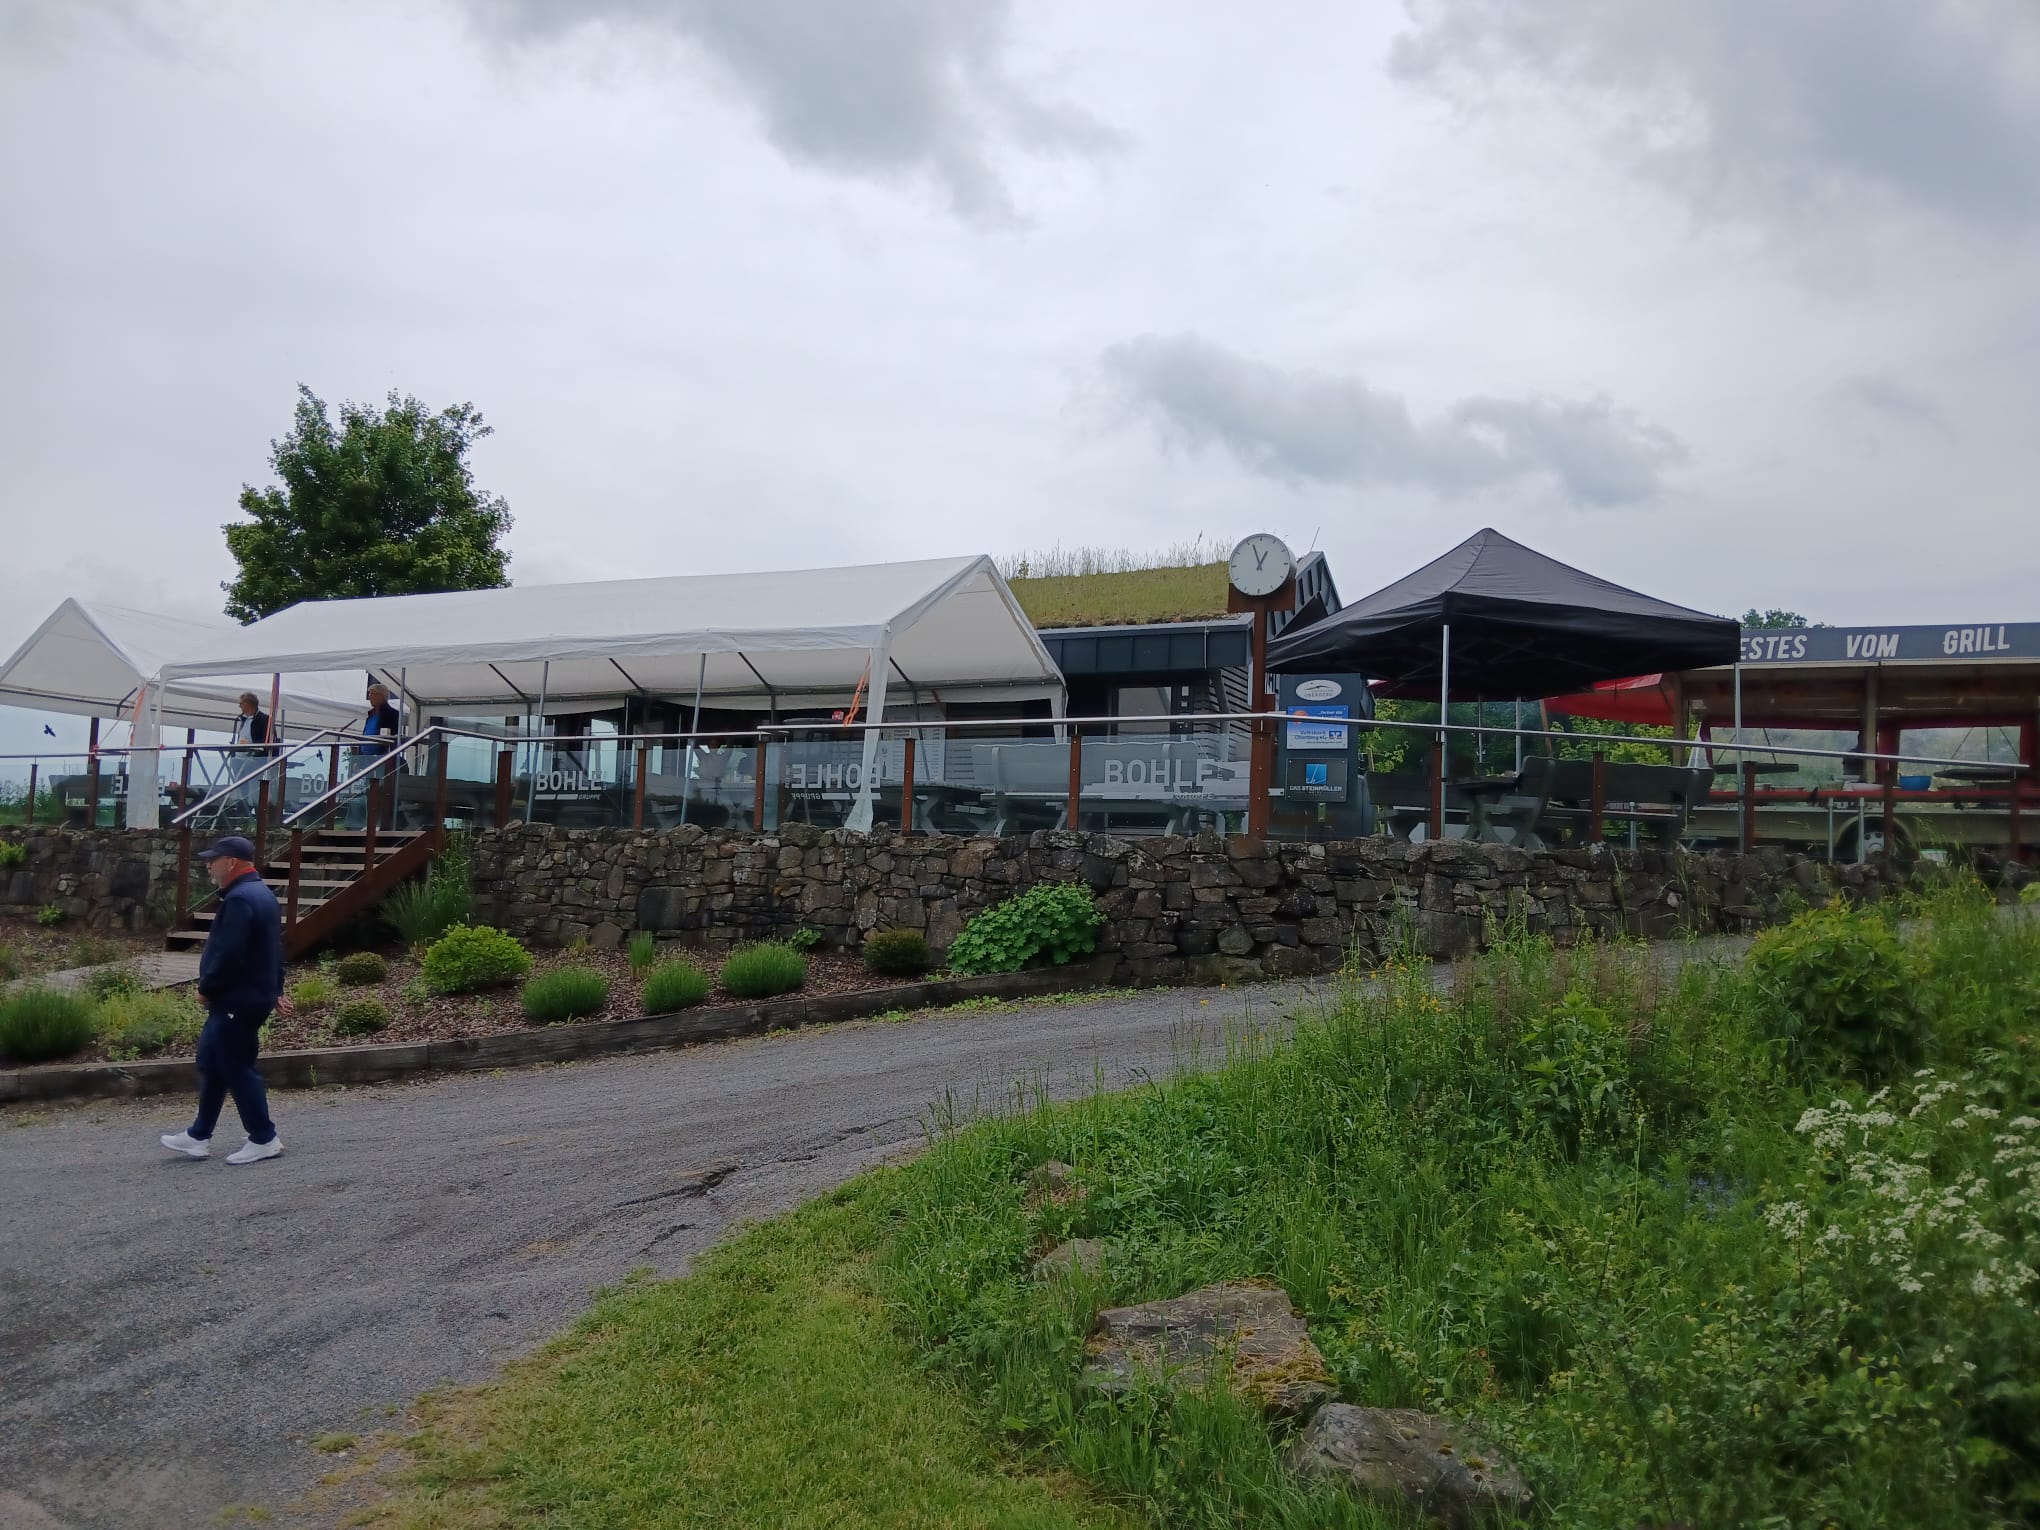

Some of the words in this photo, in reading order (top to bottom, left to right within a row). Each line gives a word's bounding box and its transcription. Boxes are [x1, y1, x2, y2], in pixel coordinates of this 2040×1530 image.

[1740, 635, 1808, 660] ESTES
[1846, 634, 1900, 658] VOM
[1942, 626, 2010, 655] GRILL
[536, 770, 602, 791] BOHLE
[1104, 759, 1215, 787] BOHLE
